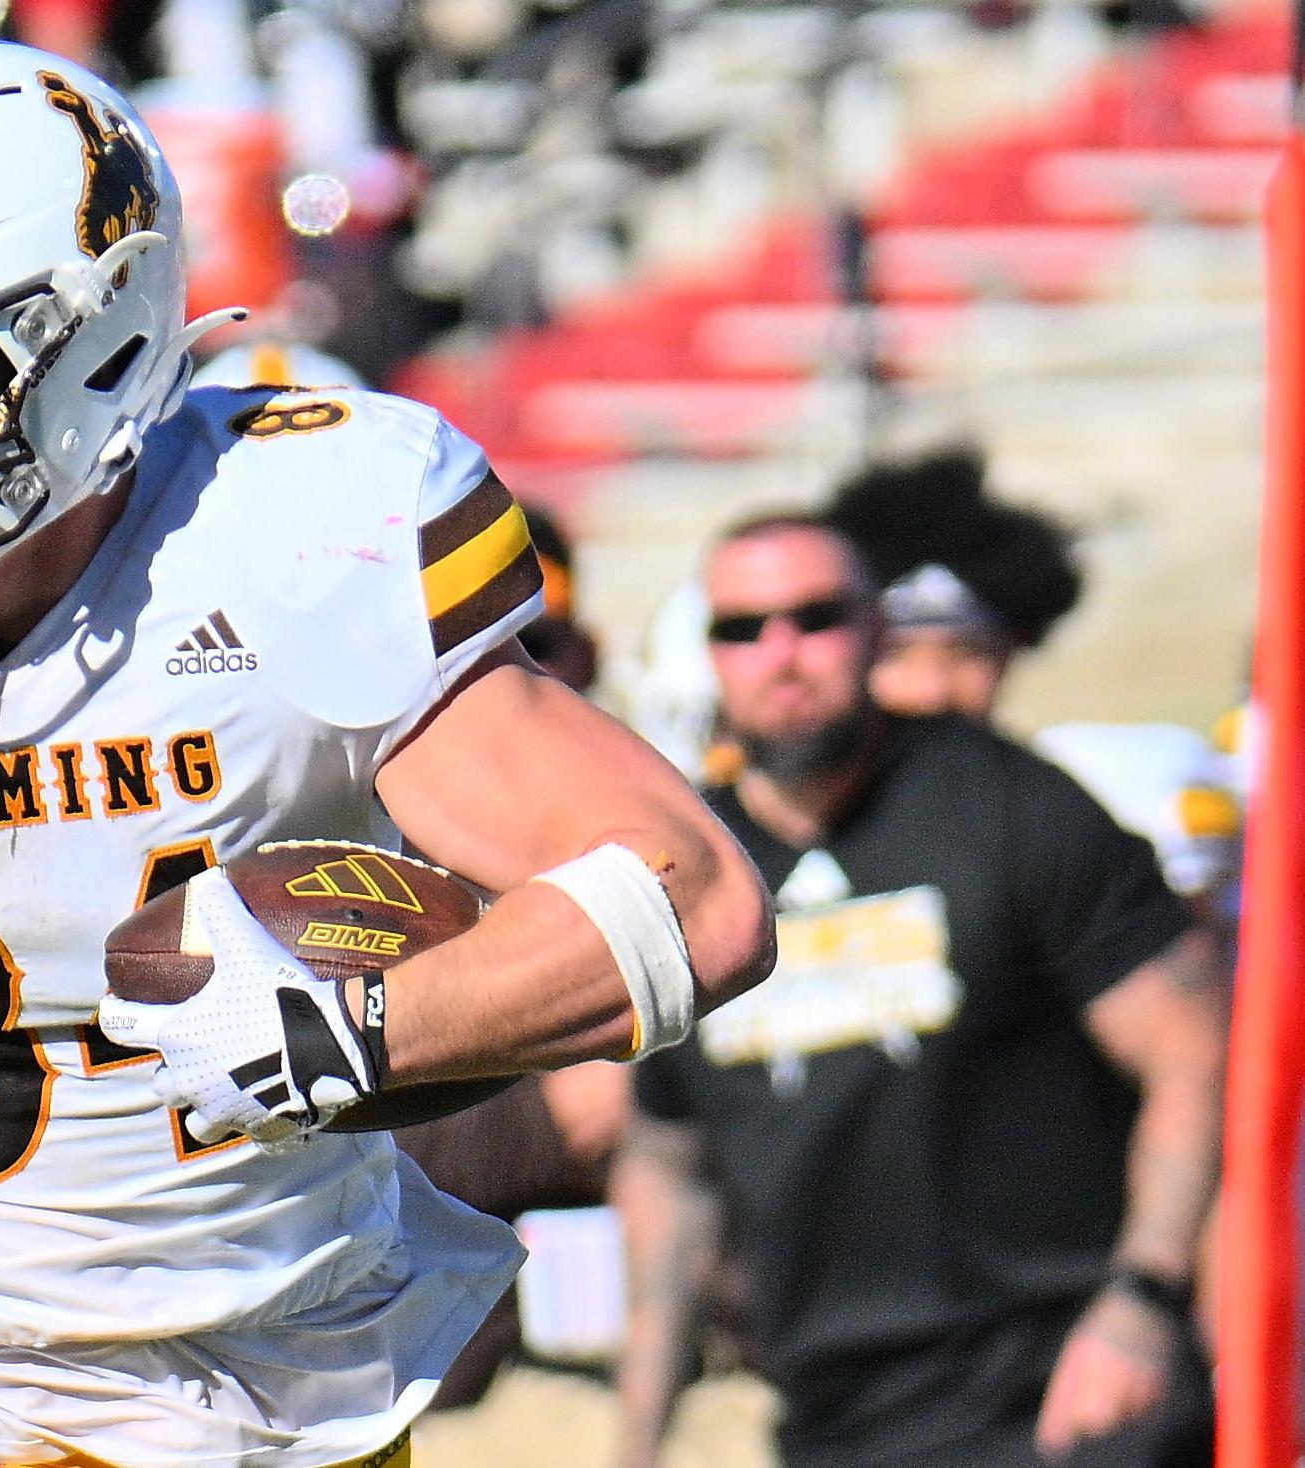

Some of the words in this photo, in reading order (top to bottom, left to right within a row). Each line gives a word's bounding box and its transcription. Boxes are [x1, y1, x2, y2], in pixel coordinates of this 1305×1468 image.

[165, 648, 257, 676] adidas
[299, 922, 406, 955] DIME
[367, 983, 384, 1027] FCA
